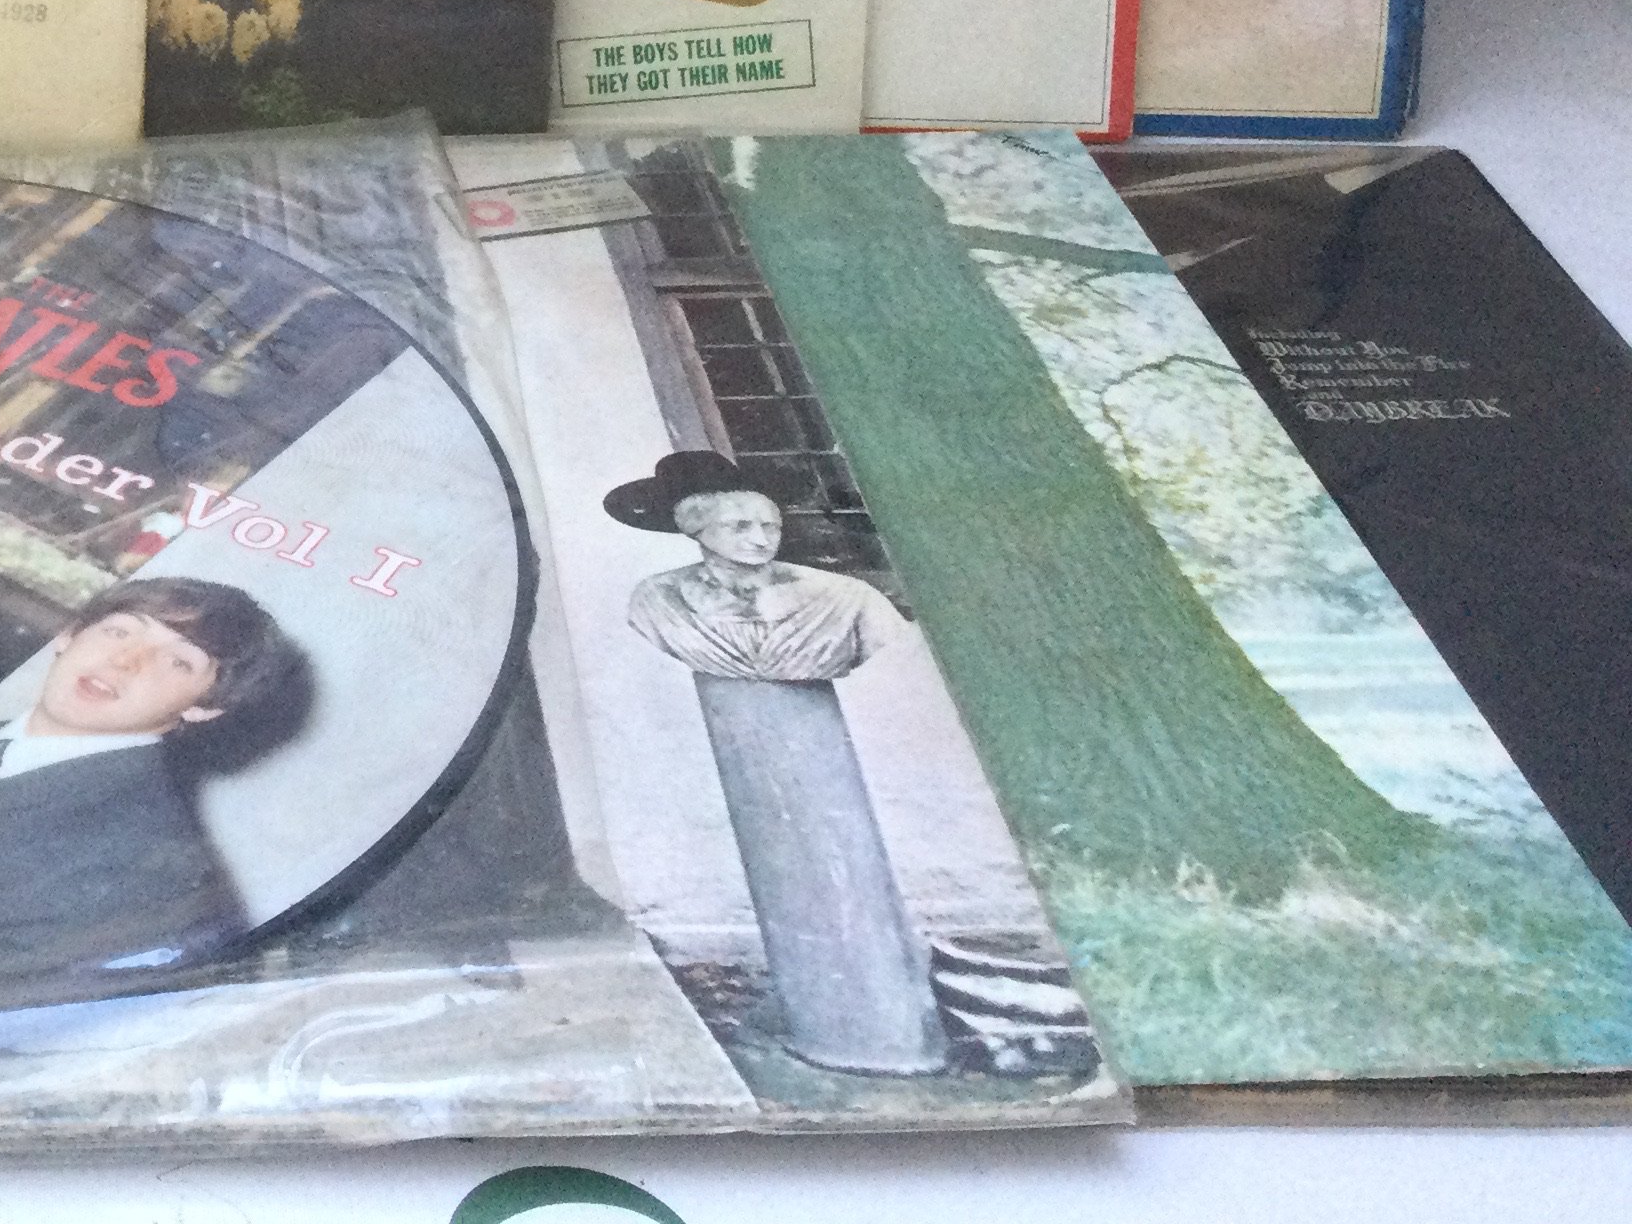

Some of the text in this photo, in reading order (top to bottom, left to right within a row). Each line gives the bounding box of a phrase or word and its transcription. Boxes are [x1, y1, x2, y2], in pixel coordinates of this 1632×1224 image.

[592, 33, 773, 67] THE BOYS TELL HOW
[585, 59, 785, 95] THEY GOT THEIR NAME
[184, 482, 330, 568] Vol
